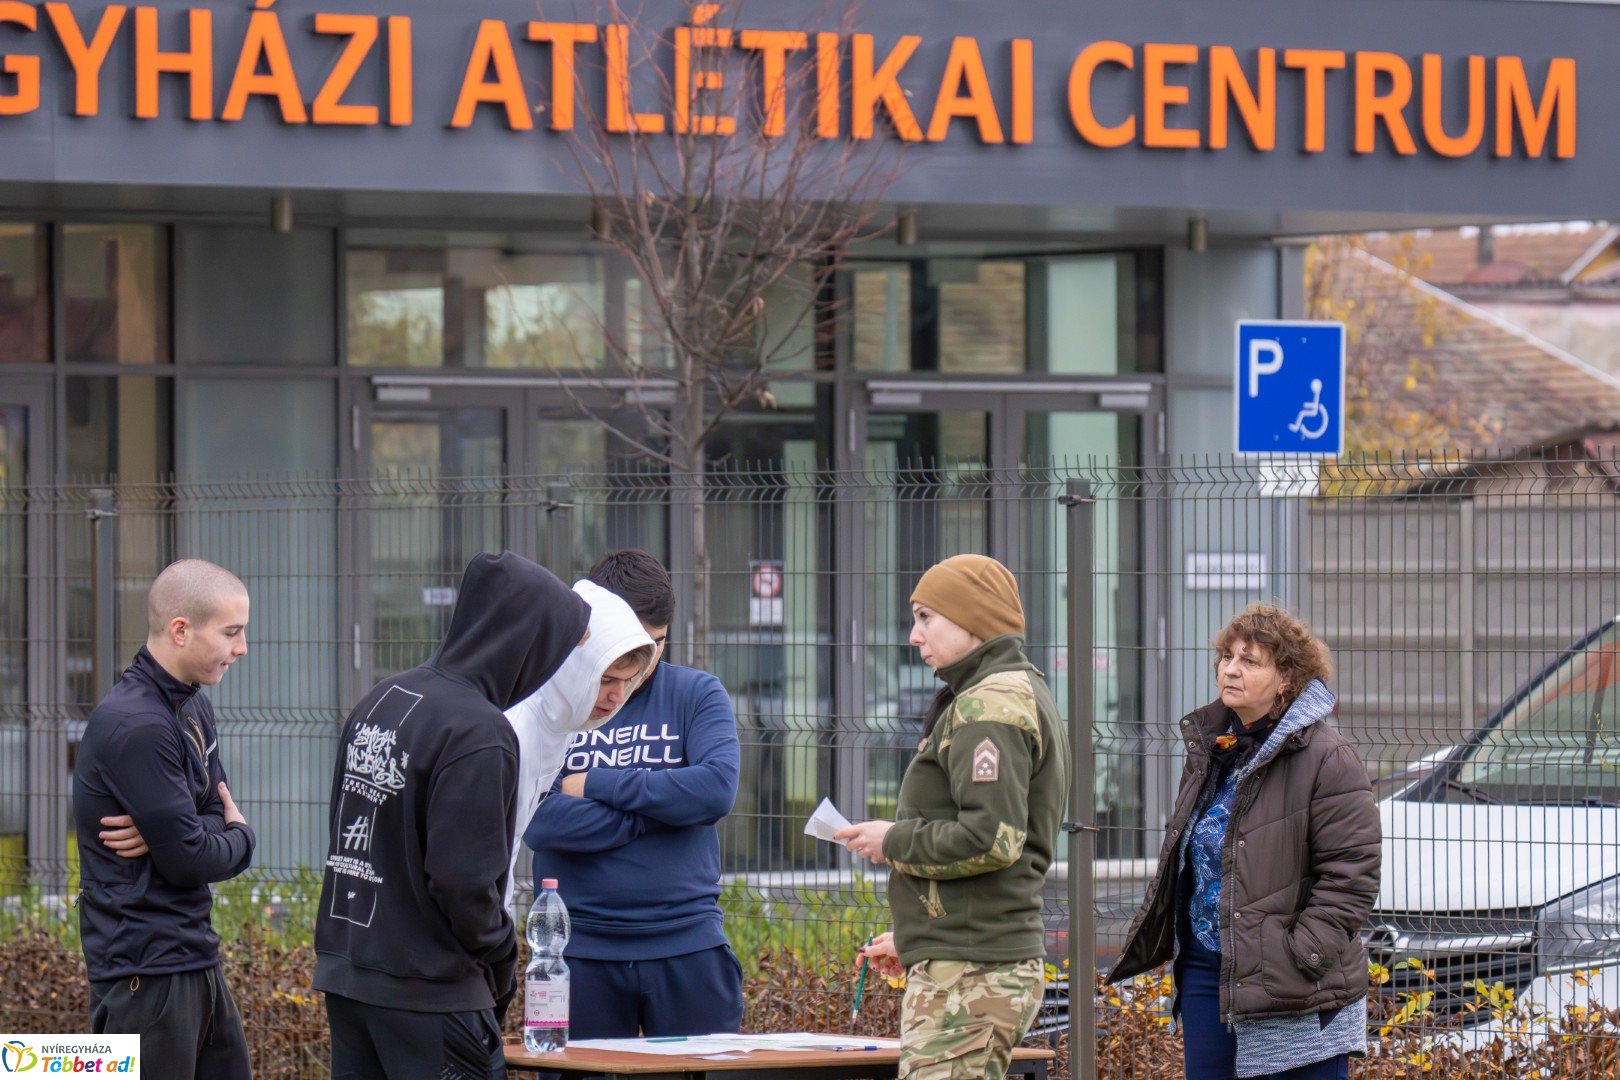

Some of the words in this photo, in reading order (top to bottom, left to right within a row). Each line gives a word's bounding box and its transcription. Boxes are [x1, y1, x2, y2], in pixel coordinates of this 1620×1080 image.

[451, 4, 1034, 144] ATLÉTIKAI
[1067, 41, 1577, 159] CENTRUM
[1249, 338, 1284, 398] P
